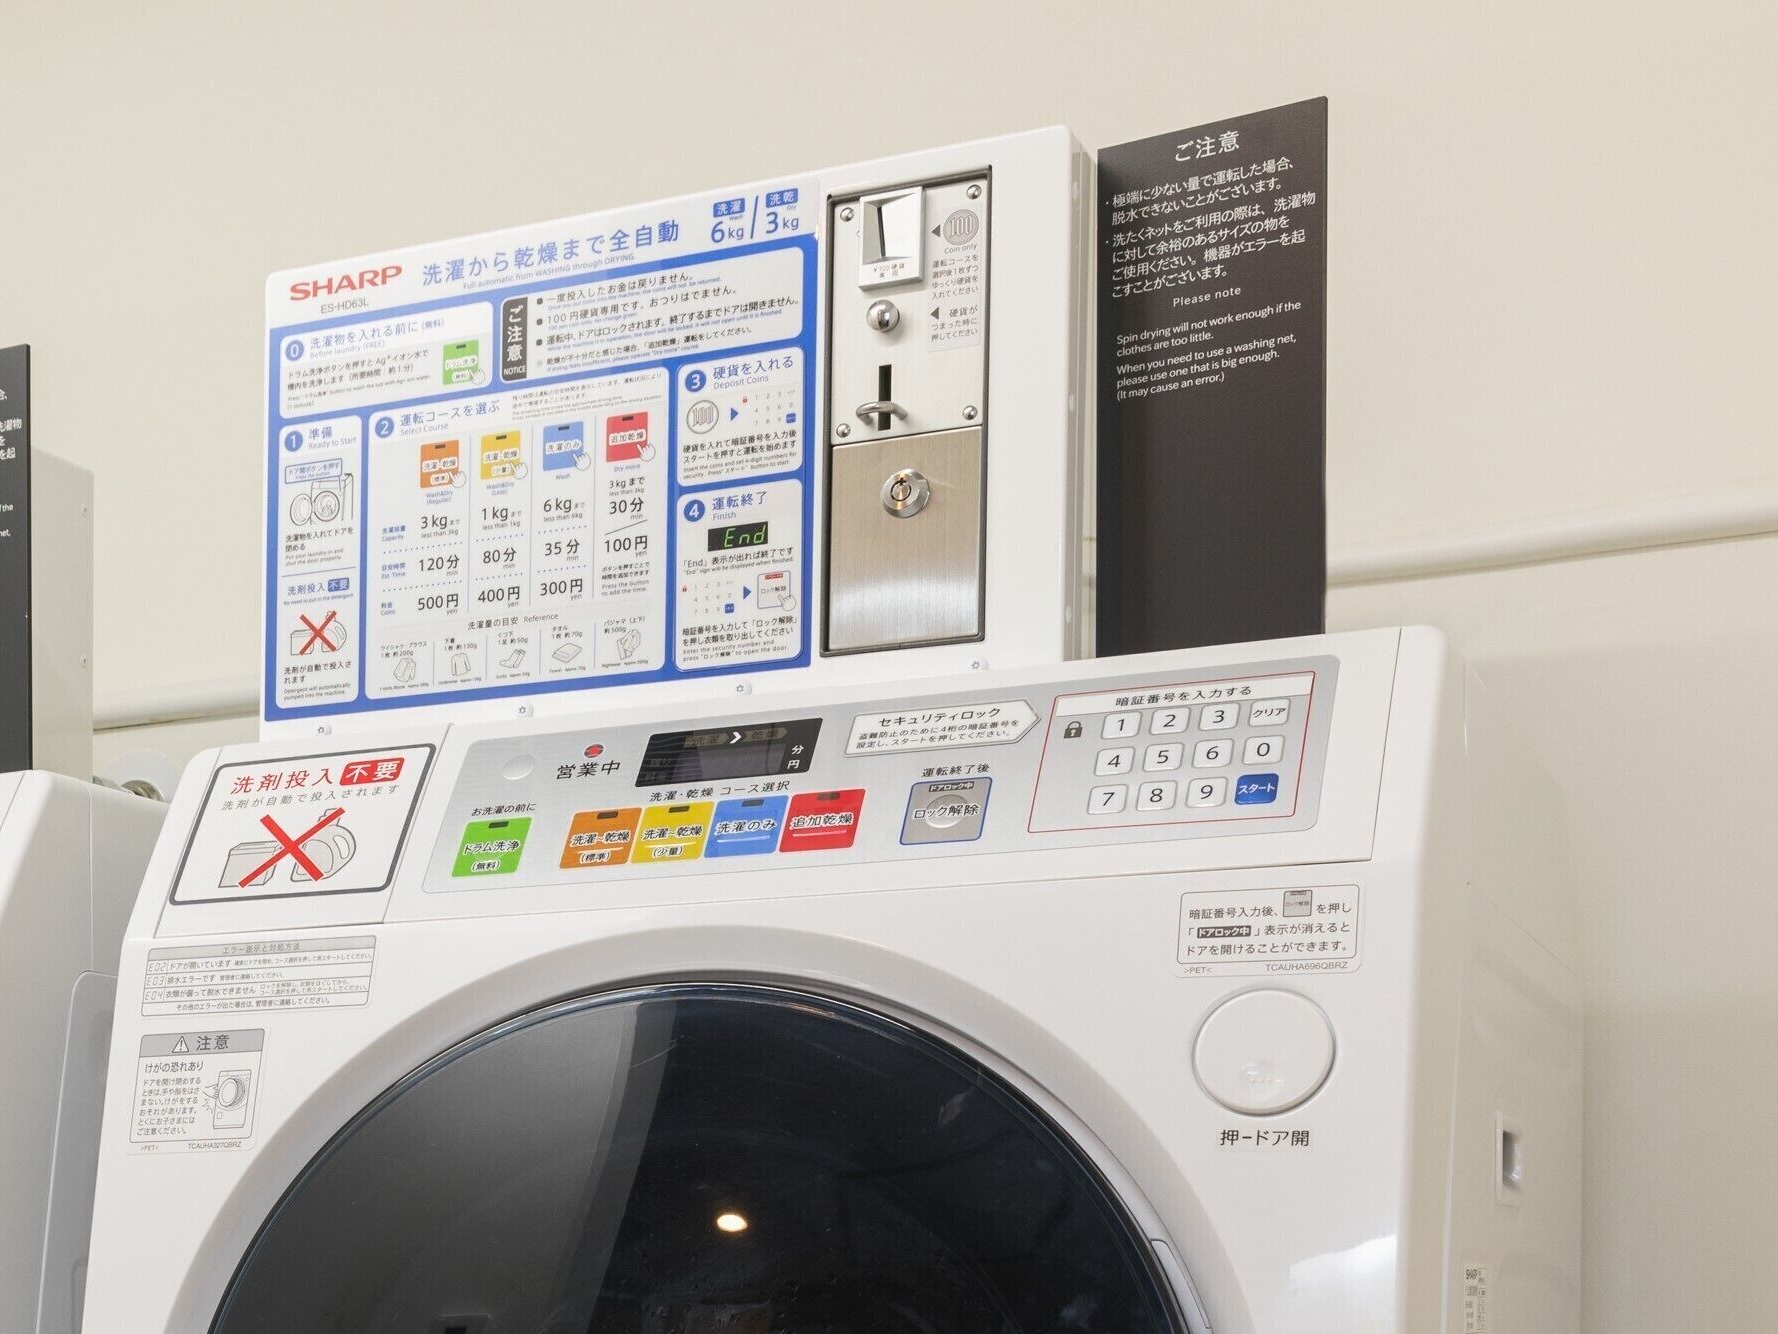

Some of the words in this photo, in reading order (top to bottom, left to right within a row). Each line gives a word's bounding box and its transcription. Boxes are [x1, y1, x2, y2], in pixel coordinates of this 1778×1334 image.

[1174, 130, 1240, 162] ご注意
[715, 200, 742, 216] 洗濯
[1112, 215, 1290, 263] に対して余裕のあるサイズの物を
[422, 219, 679, 287] 洗濯から乾燥まで全自動
[463, 276, 477, 290] Full
[479, 272, 513, 287] automatic
[515, 269, 534, 281] from
[535, 263, 571, 277] WASHING
[573, 258, 603, 271] through
[605, 253, 635, 265] DRYING
[289, 265, 402, 301] SHARP
[546, 271, 694, 304] 一度投入したお金は戻りません。
[1112, 265, 1227, 298] こすことがございます。
[1173, 293, 1211, 307] Please
[1214, 286, 1241, 300] note
[321, 298, 369, 314] ES-HD63L
[1116, 333, 1138, 346] Spin
[1140, 328, 1170, 343] drying
[1172, 322, 1189, 334] will
[1191, 320, 1208, 330] not
[1209, 314, 1234, 327] work
[1235, 306, 1274, 323] enough
[1275, 304, 1283, 313] if
[1284, 301, 1301, 312] the
[310, 321, 419, 349] 洗濯物を入れる前に
[506, 304, 524, 364] ご注意
[1116, 343, 1152, 358] clothes
[1154, 340, 1170, 352] are
[1171, 336, 1188, 347] too
[1189, 331, 1214, 344] little.
[1117, 360, 1146, 374] When
[1147, 358, 1165, 372] you
[1167, 352, 1192, 366] need
[1194, 352, 1204, 362] to
[1206, 350, 1224, 360] use
[1234, 336, 1275, 353] washing
[1276, 334, 1297, 345] net,
[503, 364, 526, 377] NOTICE
[713, 355, 794, 379] 硬貨を入れる
[1117, 373, 1148, 389] please
[1150, 370, 1168, 380] use
[1170, 366, 1188, 377] one
[1190, 361, 1210, 374] that
[1211, 359, 1220, 369] is
[1221, 356, 1237, 370] big
[1238, 350, 1280, 368] enough.
[714, 377, 744, 391] Deposit
[747, 374, 769, 386] Coins
[1117, 390, 1126, 402] (It
[1128, 386, 1148, 399] may
[1150, 381, 1179, 394] cause
[1181, 378, 1194, 388] an
[1195, 372, 1225, 387] error.)
[399, 400, 500, 425] 運転コースを選ぶ
[309, 426, 333, 438] 準備
[400, 425, 420, 436] Select
[423, 422, 449, 433] Course
[308, 440, 328, 450] Ready
[330, 439, 338, 447] to
[339, 436, 357, 446] Start
[712, 491, 767, 509] 運転終了
[713, 510, 736, 520] Finish
[604, 534, 648, 552] 100円
[724, 525, 766, 548] End
[477, 586, 520, 603] 400円
[539, 578, 583, 596] 300円
[417, 593, 459, 611] 500円
[1116, 686, 1252, 707] 暗証番号を入力する
[878, 708, 1001, 727] セキュリティロック
[1117, 719, 1125, 732] 1
[1163, 714, 1176, 728] 2
[1214, 710, 1225, 724] 3
[1252, 707, 1287, 721] クリア
[858, 719, 1019, 740] 盗難防止のために4桁の暗証番号を
[856, 731, 1010, 750] 設定し、スタートを押してください。
[791, 745, 804, 755] 分
[1107, 755, 1121, 768] 4
[1157, 750, 1169, 764] 5
[1207, 745, 1219, 760] 6
[1257, 743, 1270, 757] 0
[556, 760, 621, 780] 営業中
[787, 759, 800, 769] 円
[922, 763, 990, 778] 運転終了後
[230, 768, 333, 795] 洗剤投入
[346, 760, 399, 782] 不要
[720, 780, 791, 796] コース選択
[929, 782, 974, 792] ドアロック中
[1102, 792, 1114, 806] 7
[1150, 788, 1163, 803] 8
[1200, 784, 1213, 799] 9
[1239, 781, 1275, 798] スタート
[222, 784, 401, 811] 洗剤が自動で投入されます
[471, 802, 536, 817] お洗濯の前に
[914, 803, 978, 820] ロック解除
[718, 820, 776, 833] 洗濯のみ
[791, 813, 852, 829] 追加乾燥
[463, 840, 520, 854] ドラム洗浄
[1189, 906, 1278, 919] 暗証番号入力後、
[1316, 903, 1351, 914] を押し
[1186, 941, 1347, 956] ドアを開けることができます。
[196, 1035, 230, 1051] 注意
[144, 1061, 204, 1073] けがの恐れあり
